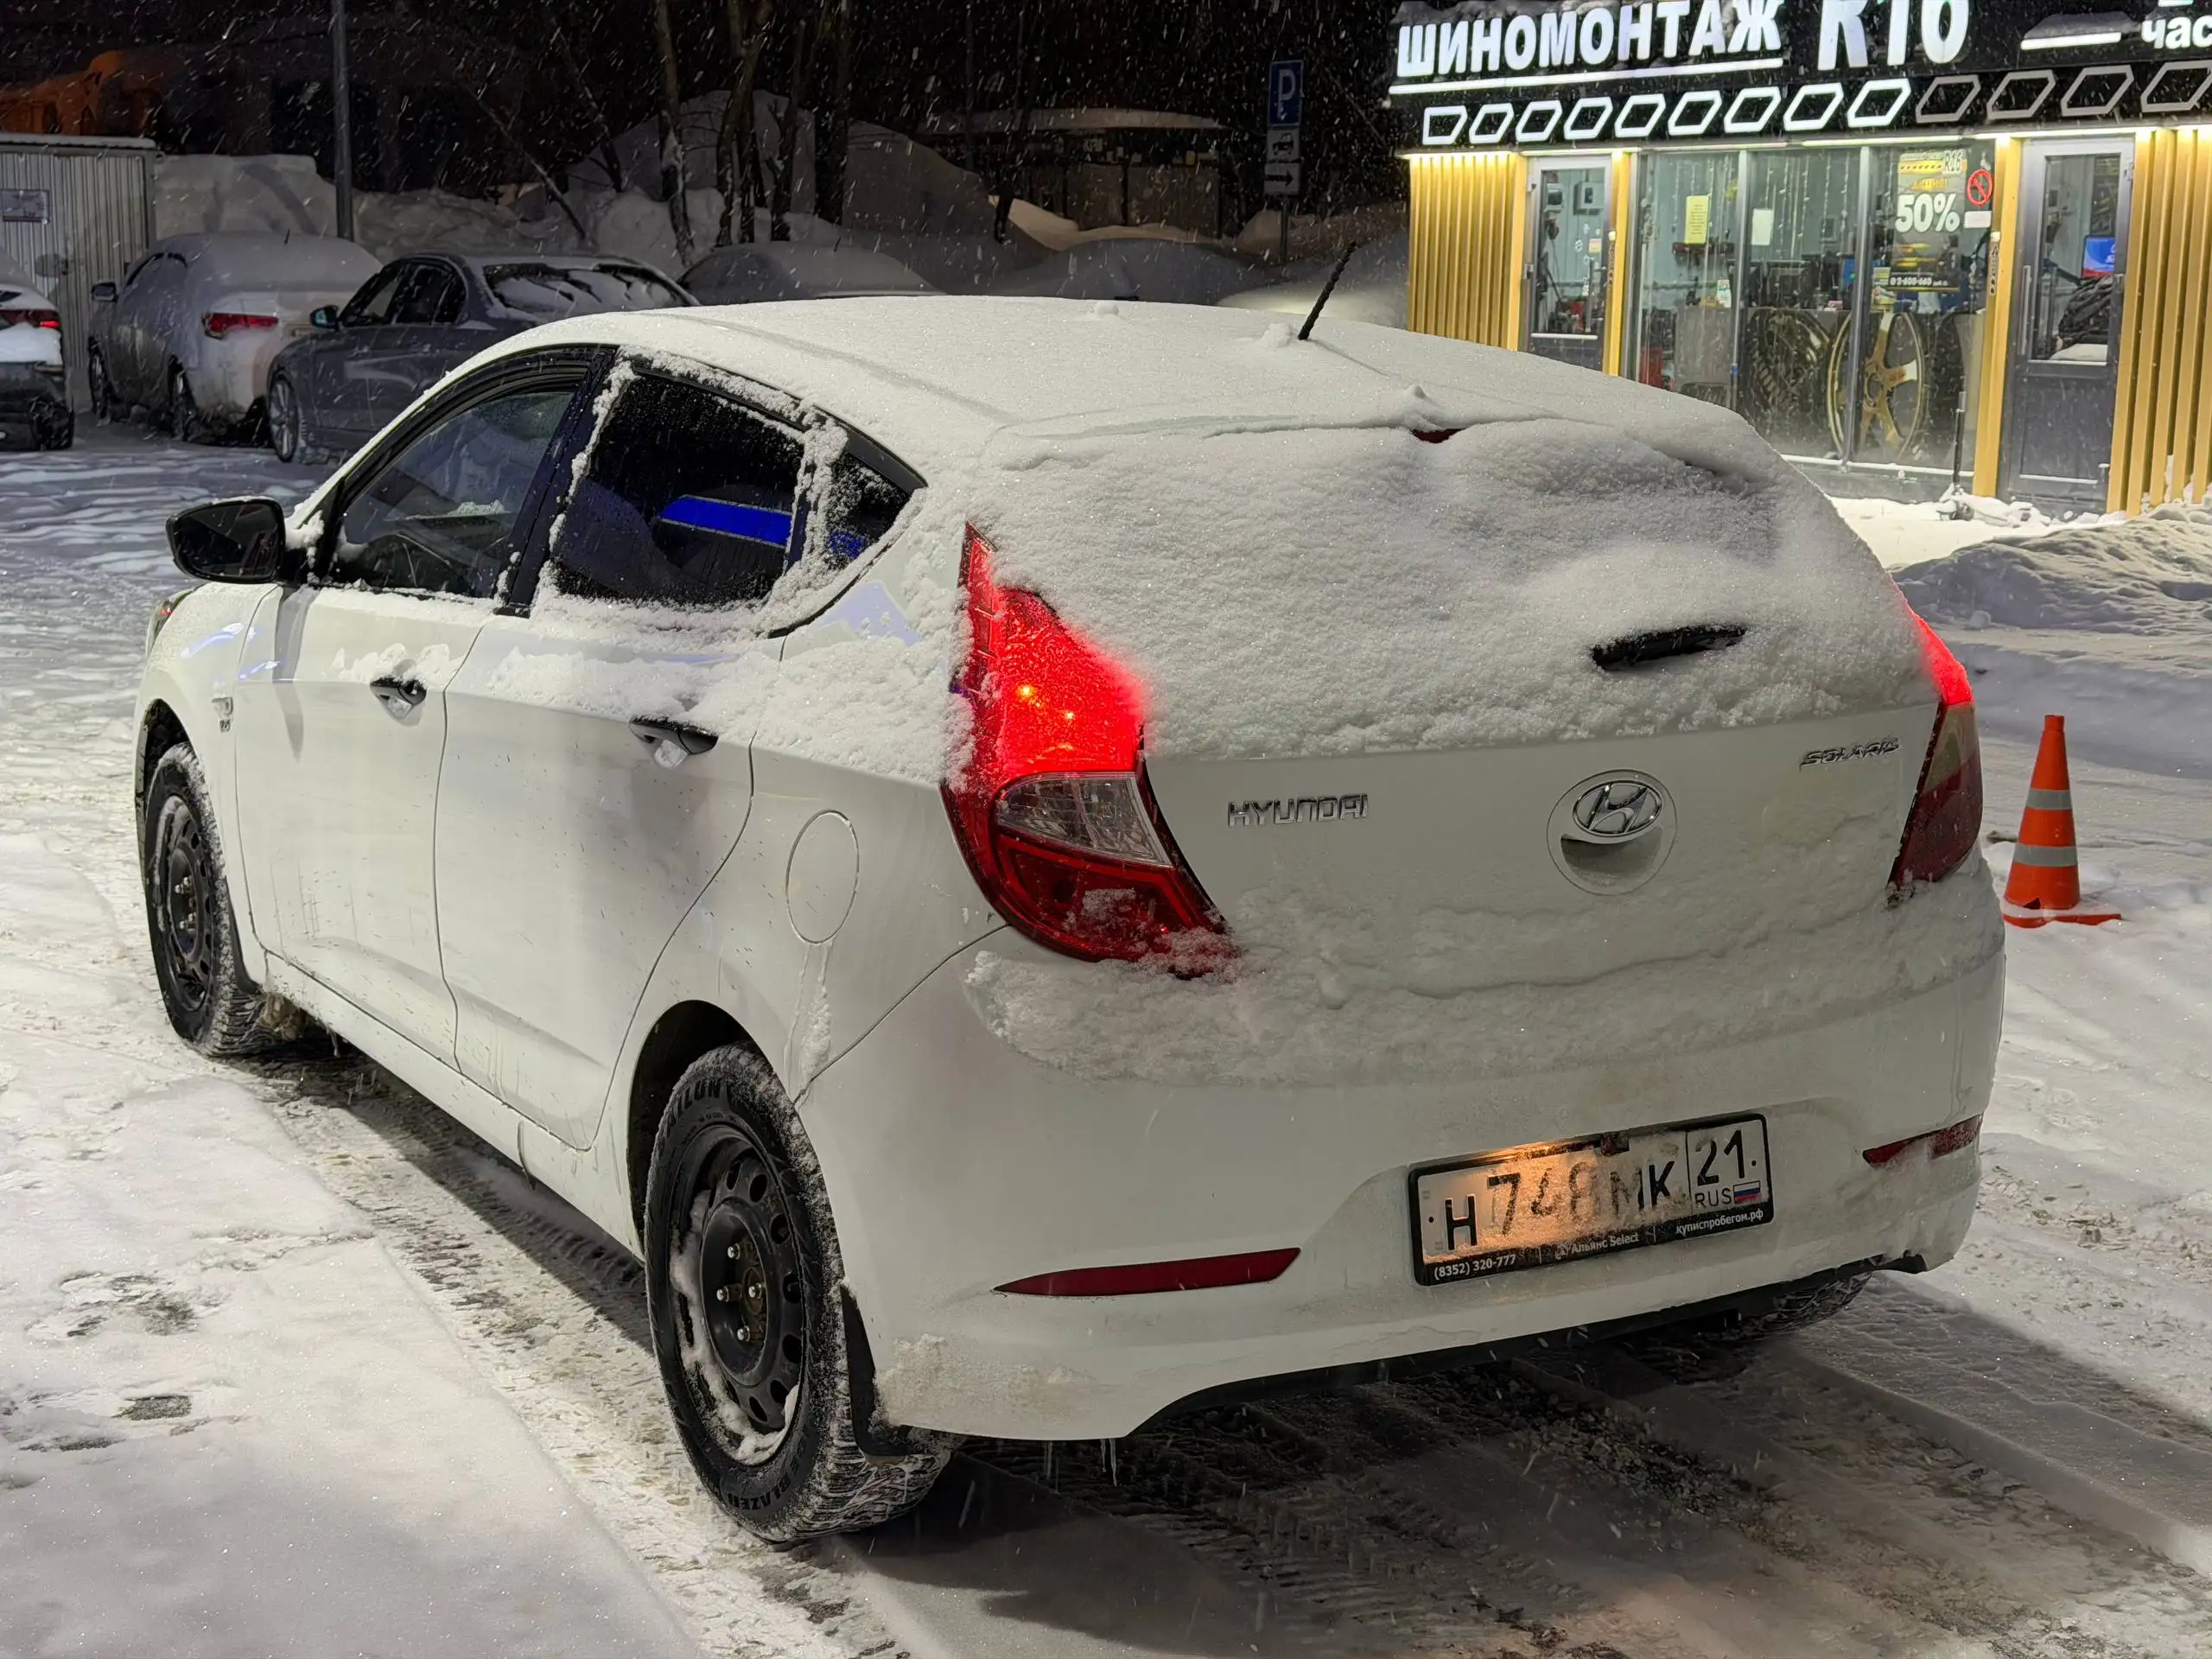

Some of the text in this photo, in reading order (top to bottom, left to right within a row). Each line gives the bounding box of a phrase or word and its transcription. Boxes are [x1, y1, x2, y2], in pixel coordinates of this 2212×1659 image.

[1396, 0, 1784, 78] ШИНОМОНТАЖ
[1895, 193, 1961, 232] 50%
[1227, 793, 1369, 829] HYUNDAI
[1694, 1129, 1745, 1186] 21
[1694, 1187, 1732, 1209] RUS
[1433, 1208, 1764, 1281] (8352) 320-777 Альянс Select куписпробегом.рф
